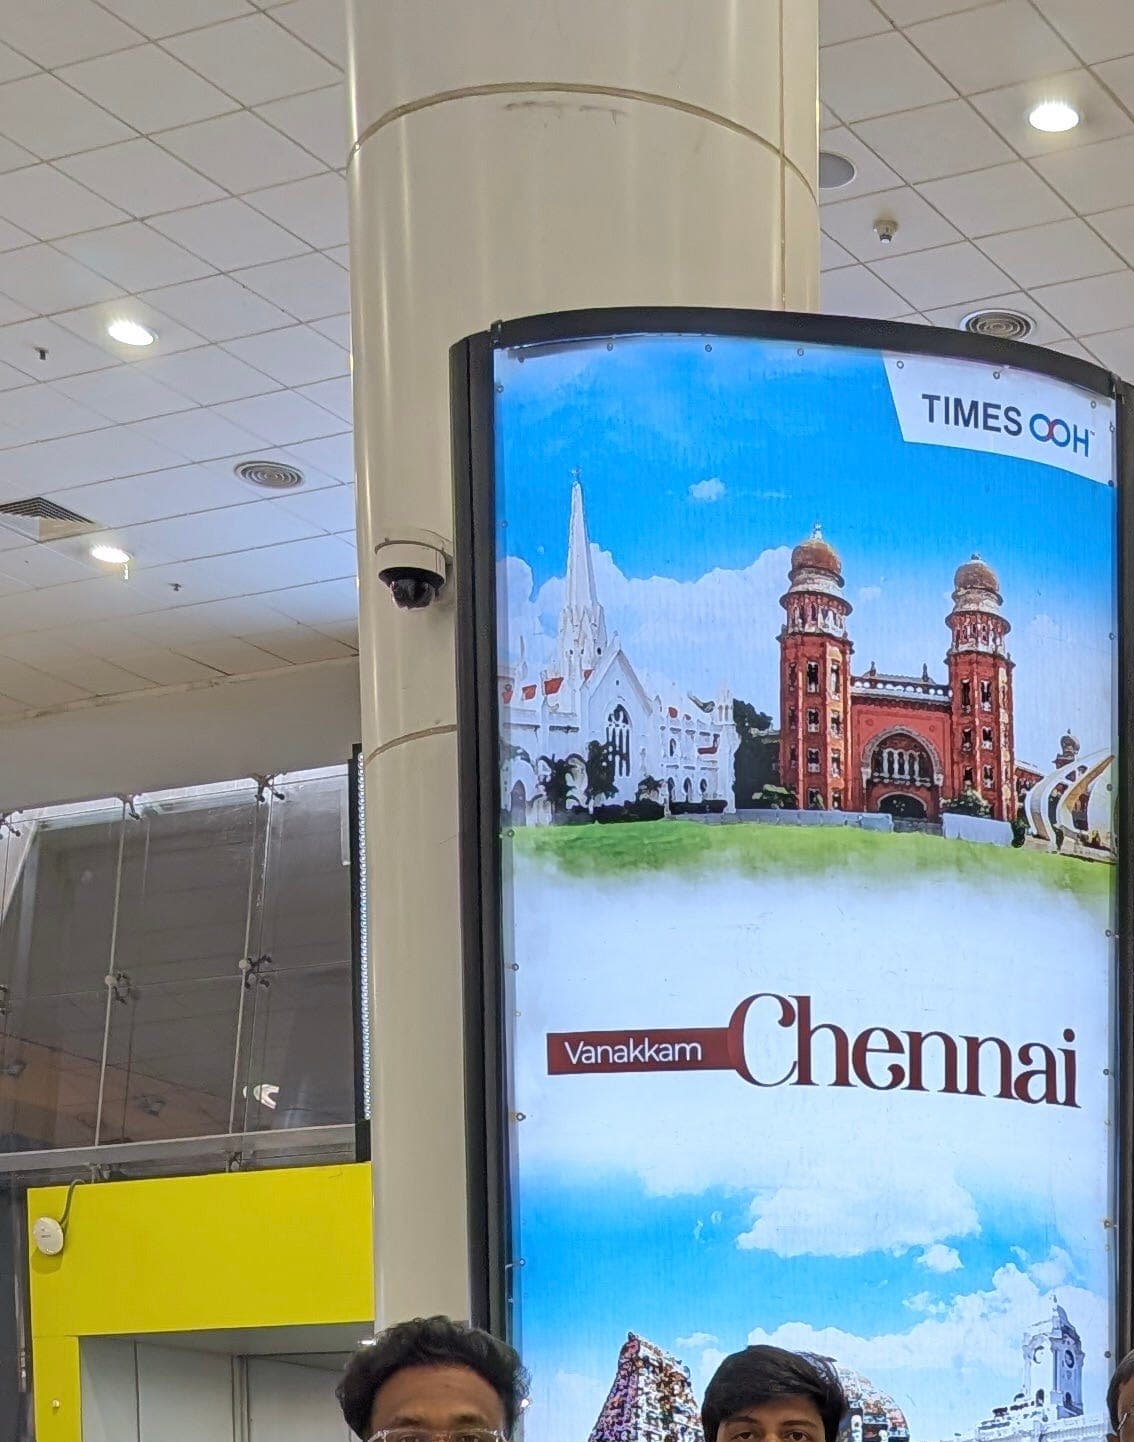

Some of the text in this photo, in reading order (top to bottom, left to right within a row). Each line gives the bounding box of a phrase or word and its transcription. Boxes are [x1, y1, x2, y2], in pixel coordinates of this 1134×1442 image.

[921, 393, 1023, 437] TIMES
[564, 991, 1082, 1109] Vanakkam Chennai
